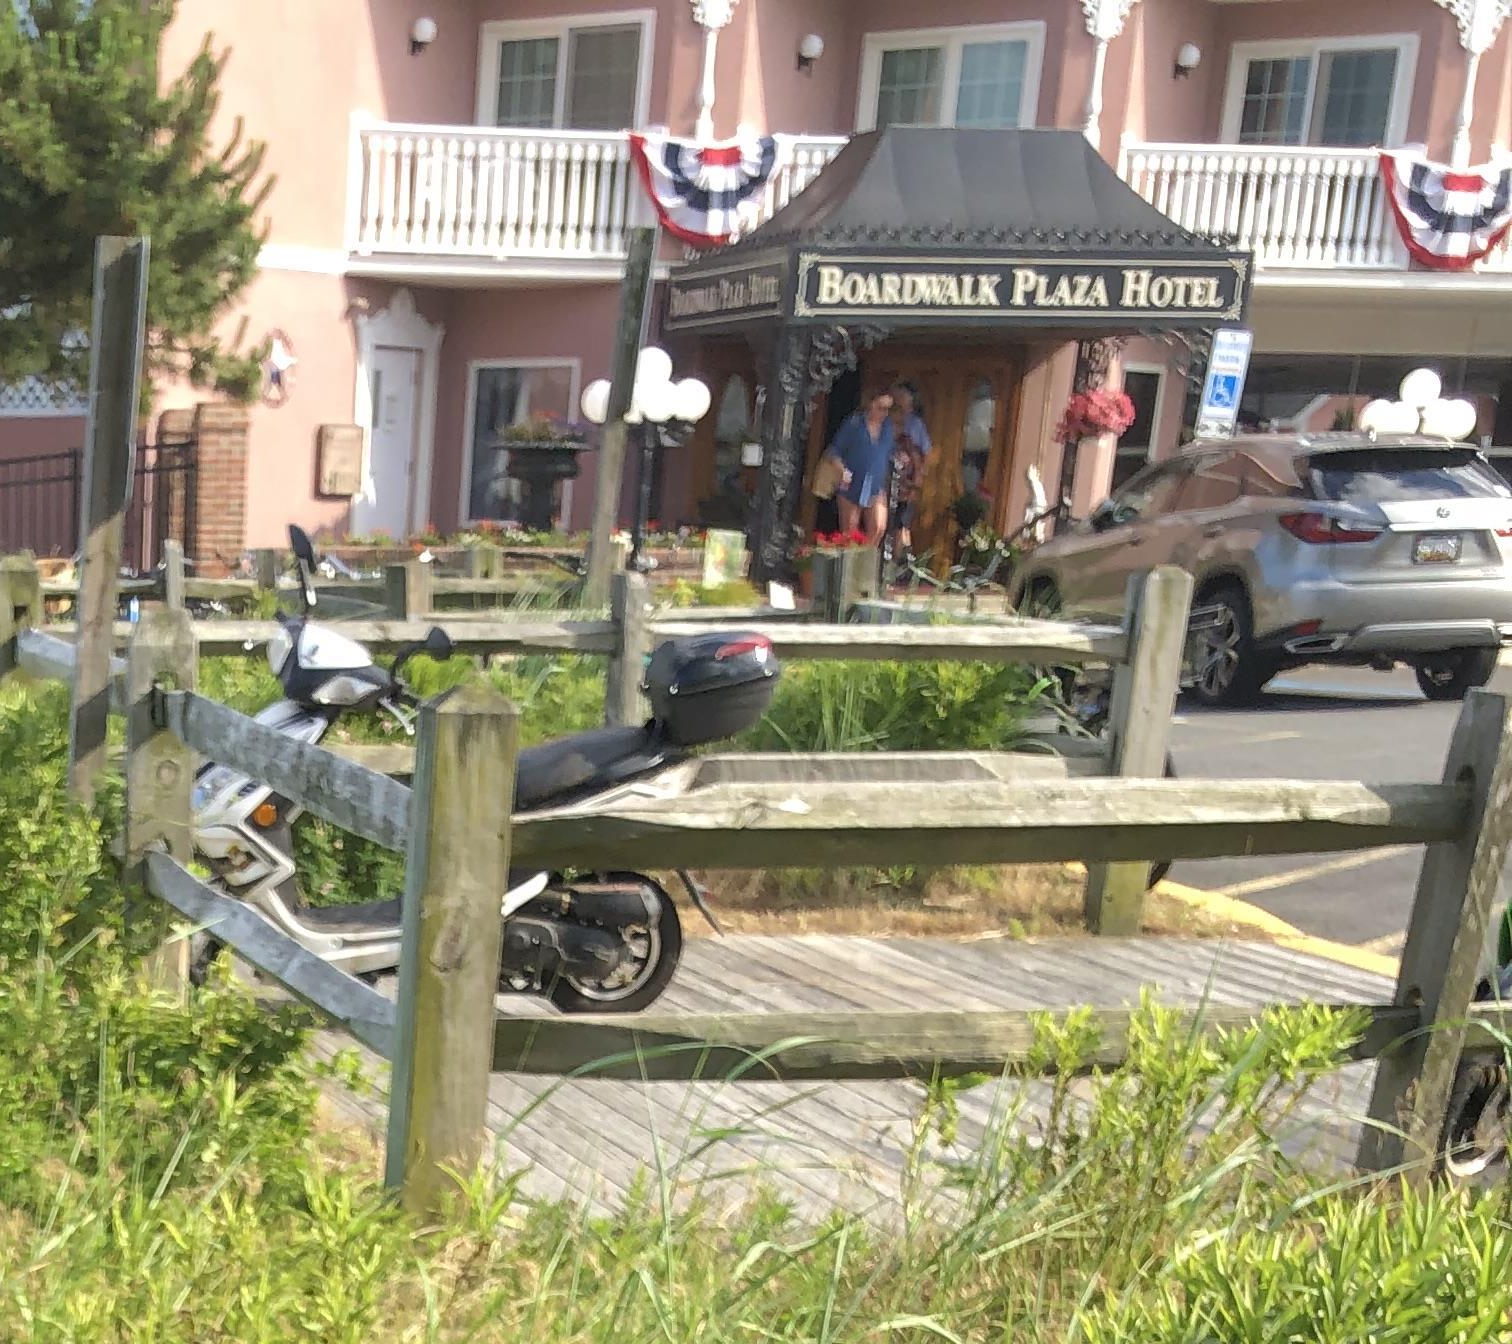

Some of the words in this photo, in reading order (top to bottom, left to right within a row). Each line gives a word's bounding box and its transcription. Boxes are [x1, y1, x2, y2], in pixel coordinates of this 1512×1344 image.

[816, 265, 1002, 306] BOARDWALK
[1010, 268, 1110, 307] PLAZA
[1119, 269, 1225, 308] HOTEL
